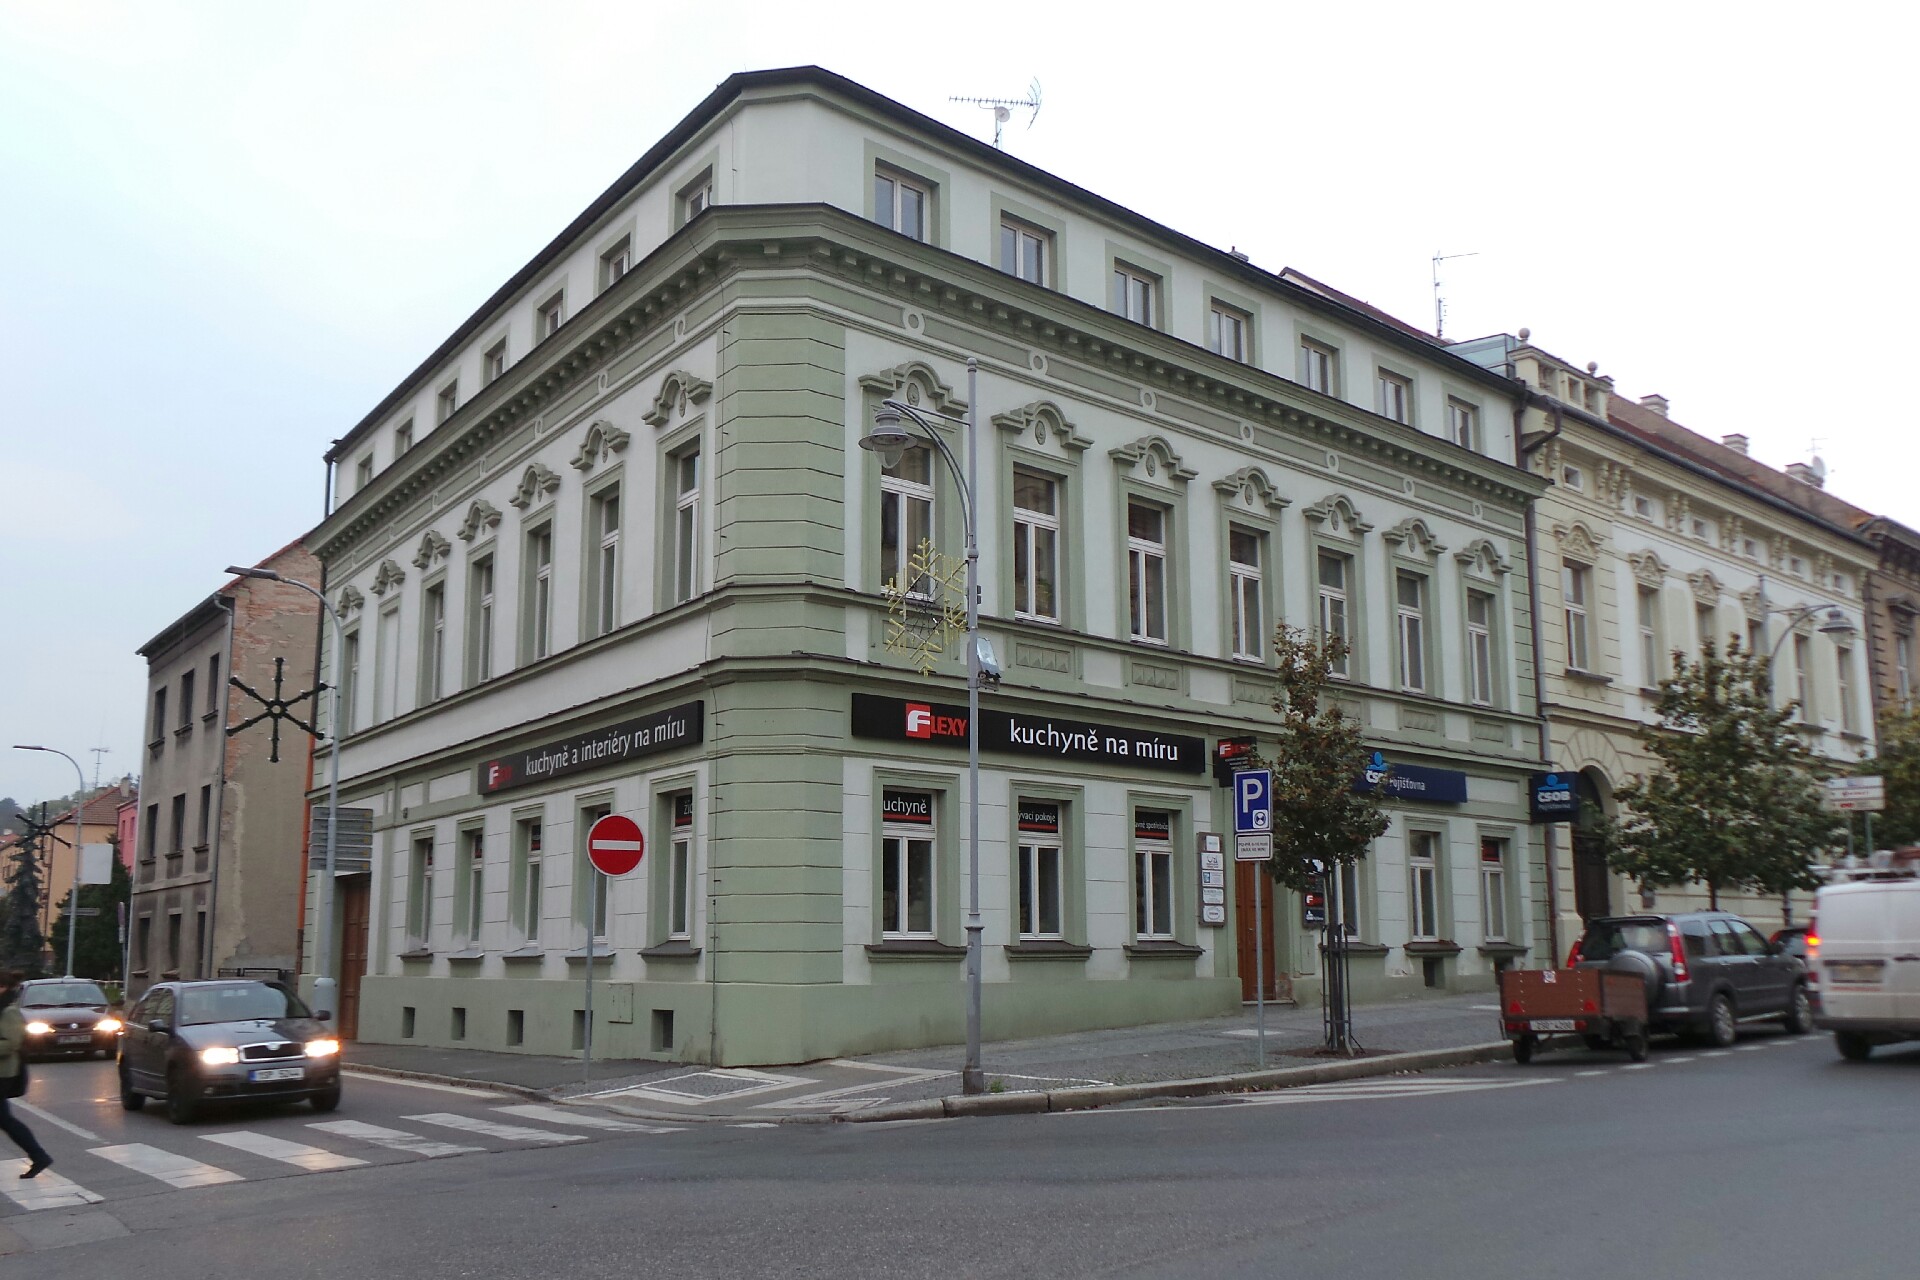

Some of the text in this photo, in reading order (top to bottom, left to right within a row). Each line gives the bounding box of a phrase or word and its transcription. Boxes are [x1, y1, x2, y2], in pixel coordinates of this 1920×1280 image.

[907, 709, 968, 737] FLEXY
[1010, 718, 1178, 761] kuchyně na míru
[525, 746, 569, 776] kuchyně
[571, 749, 578, 764] a
[581, 730, 631, 762] interiéry
[634, 730, 650, 748] na
[654, 715, 686, 743] míru
[1242, 778, 1263, 813] P
